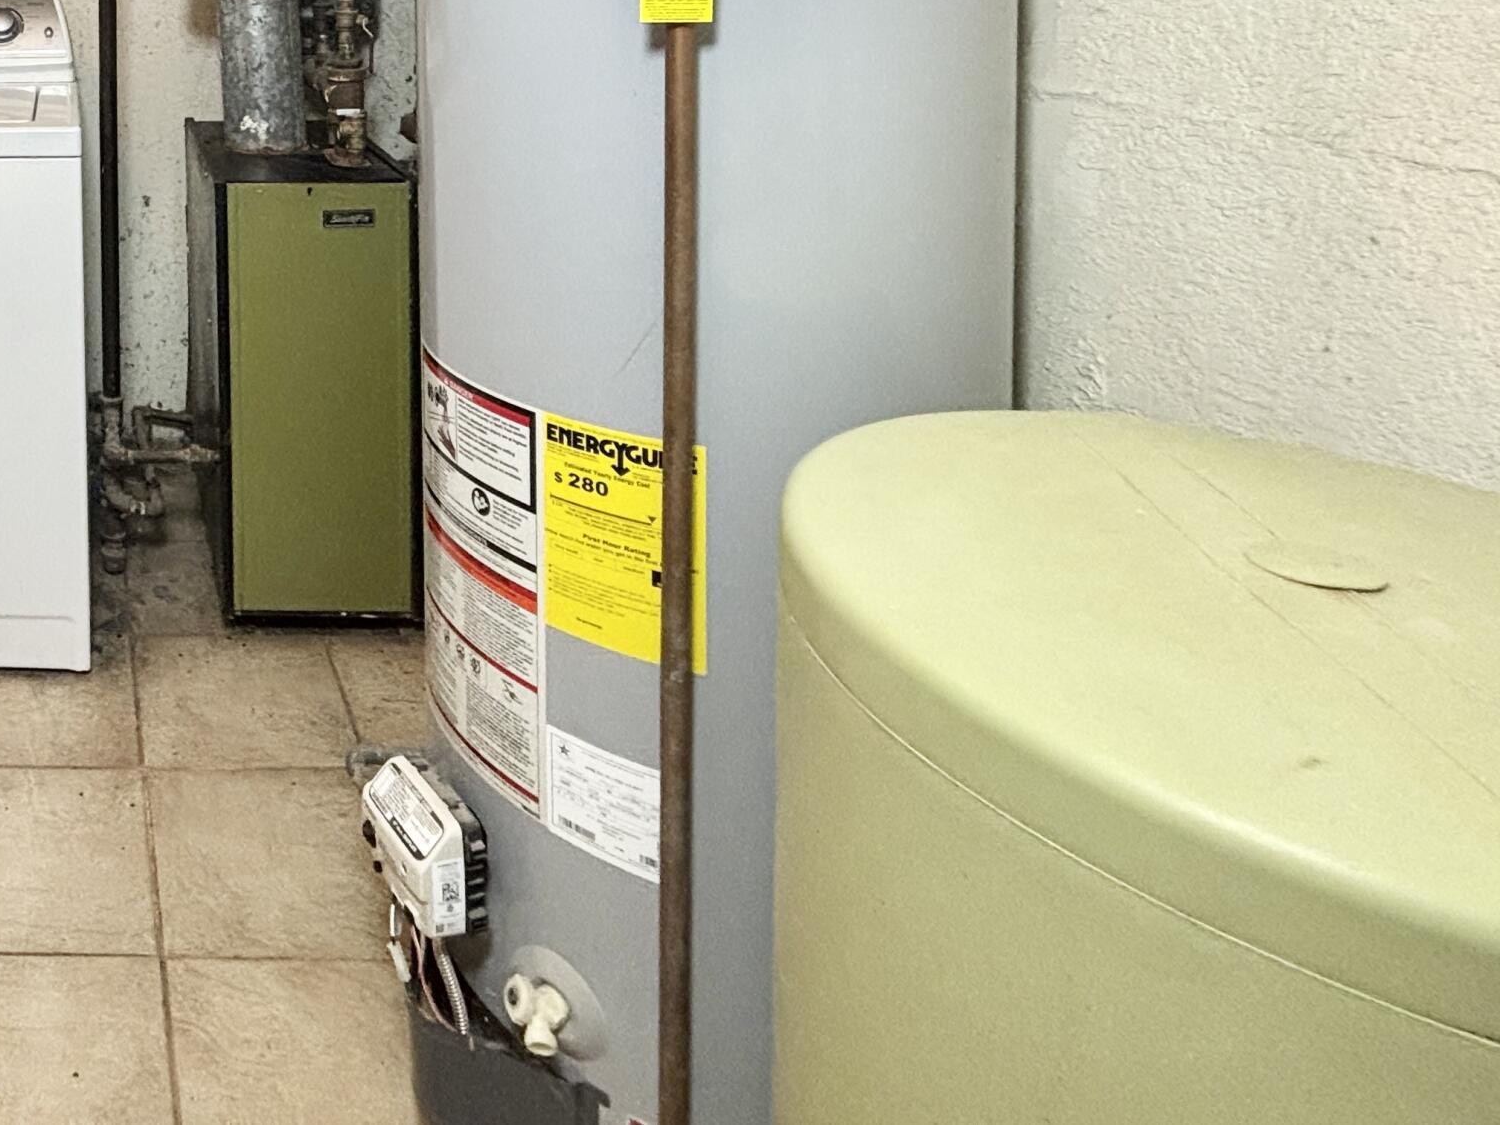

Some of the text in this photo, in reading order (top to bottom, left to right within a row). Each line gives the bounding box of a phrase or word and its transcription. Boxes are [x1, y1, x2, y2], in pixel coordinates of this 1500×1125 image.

[554, 472, 609, 497] $ 280
[624, 545, 651, 559] Rating
